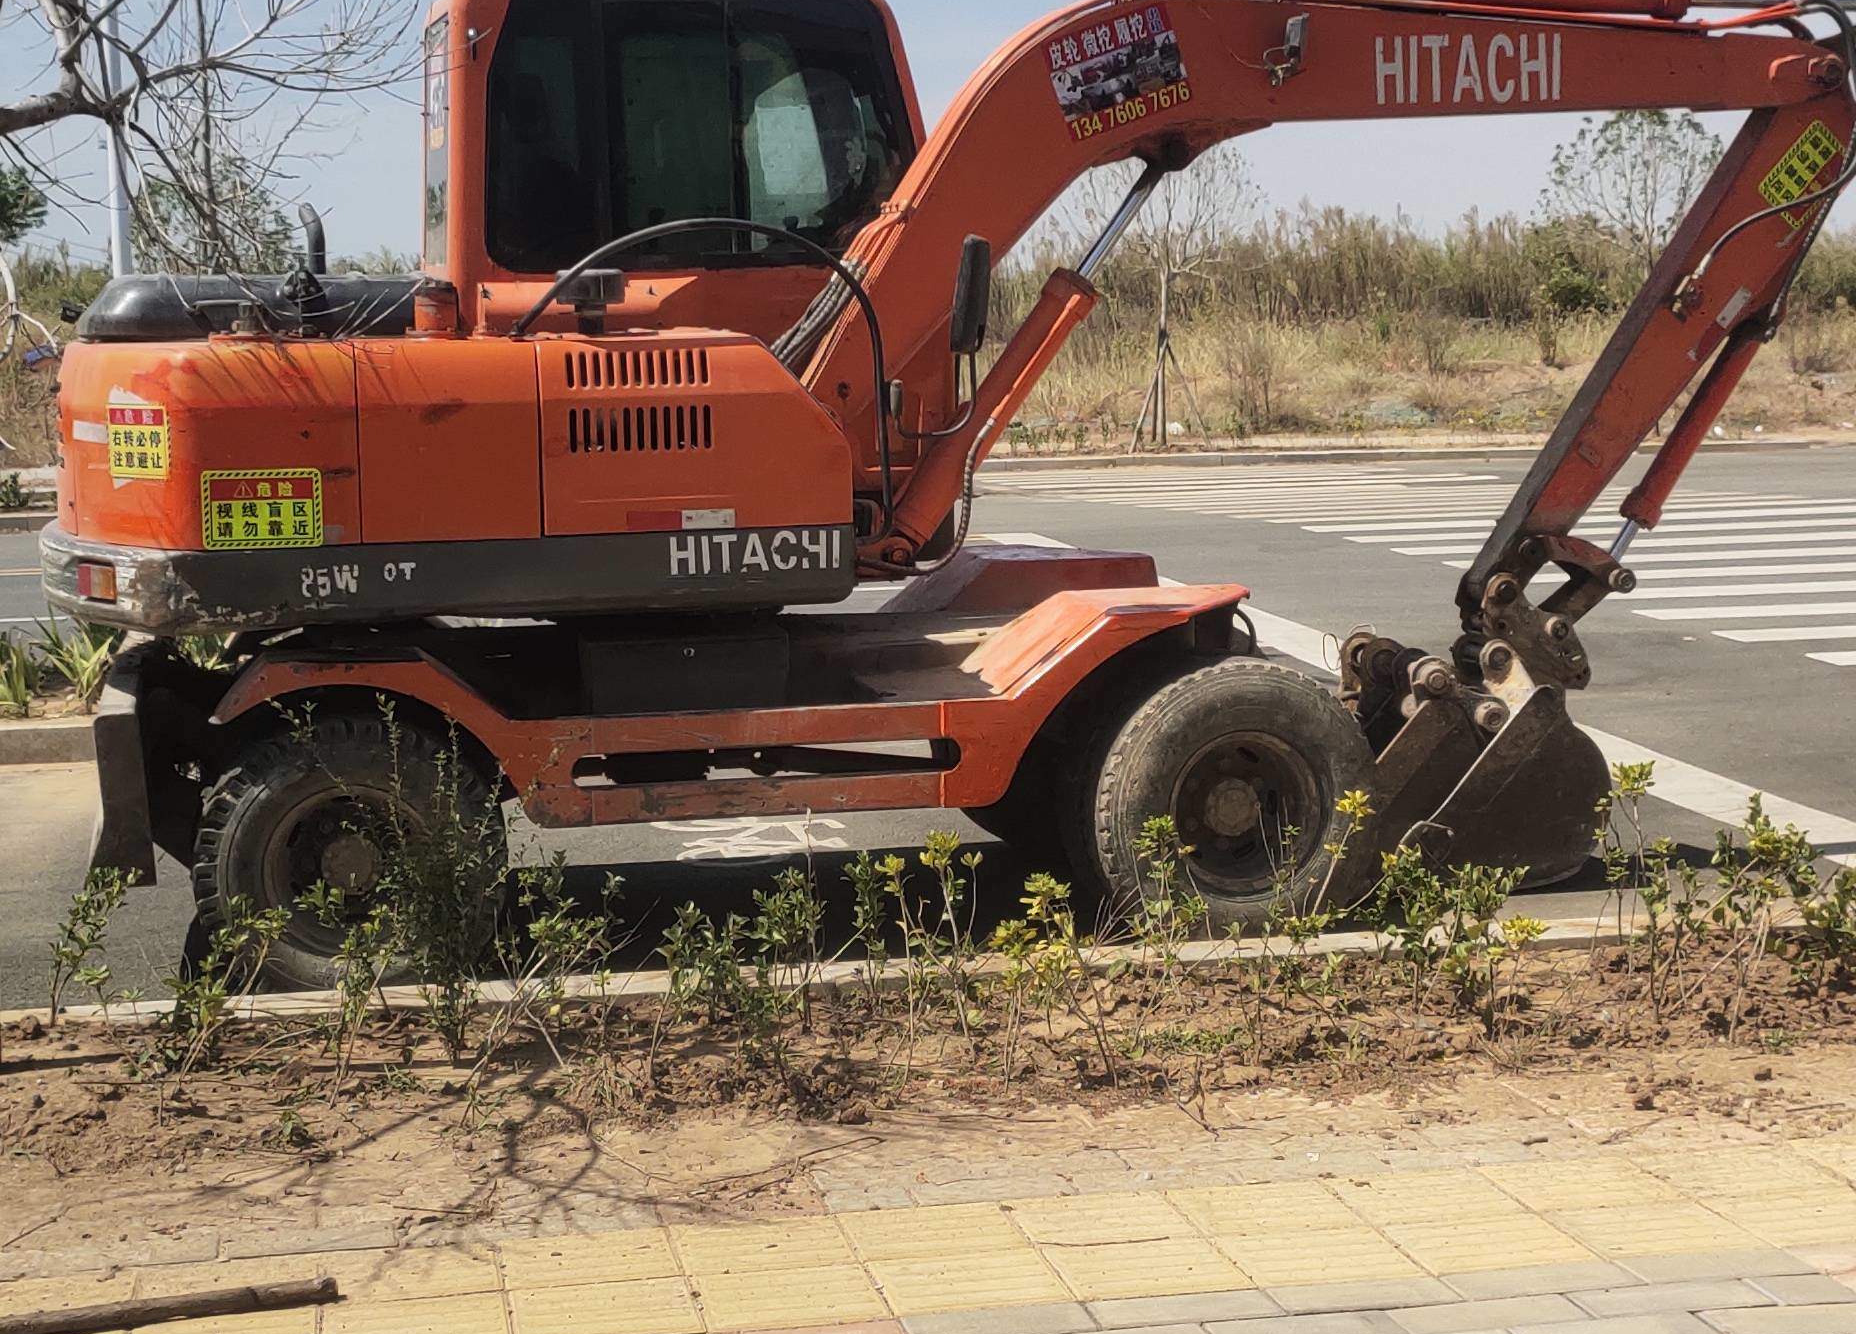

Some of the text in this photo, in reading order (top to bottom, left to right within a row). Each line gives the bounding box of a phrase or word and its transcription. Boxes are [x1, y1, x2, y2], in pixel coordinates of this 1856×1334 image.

[1375, 32, 1562, 105] HITACHI
[1071, 81, 1191, 140] 134 7606 7676
[112, 429, 162, 448] 右转必停
[113, 450, 163, 469] 注意避让
[256, 480, 293, 498] 危险
[216, 500, 308, 519] 视线盲区
[217, 519, 309, 538] 请勿靠近
[669, 529, 841, 576] HITACHI
